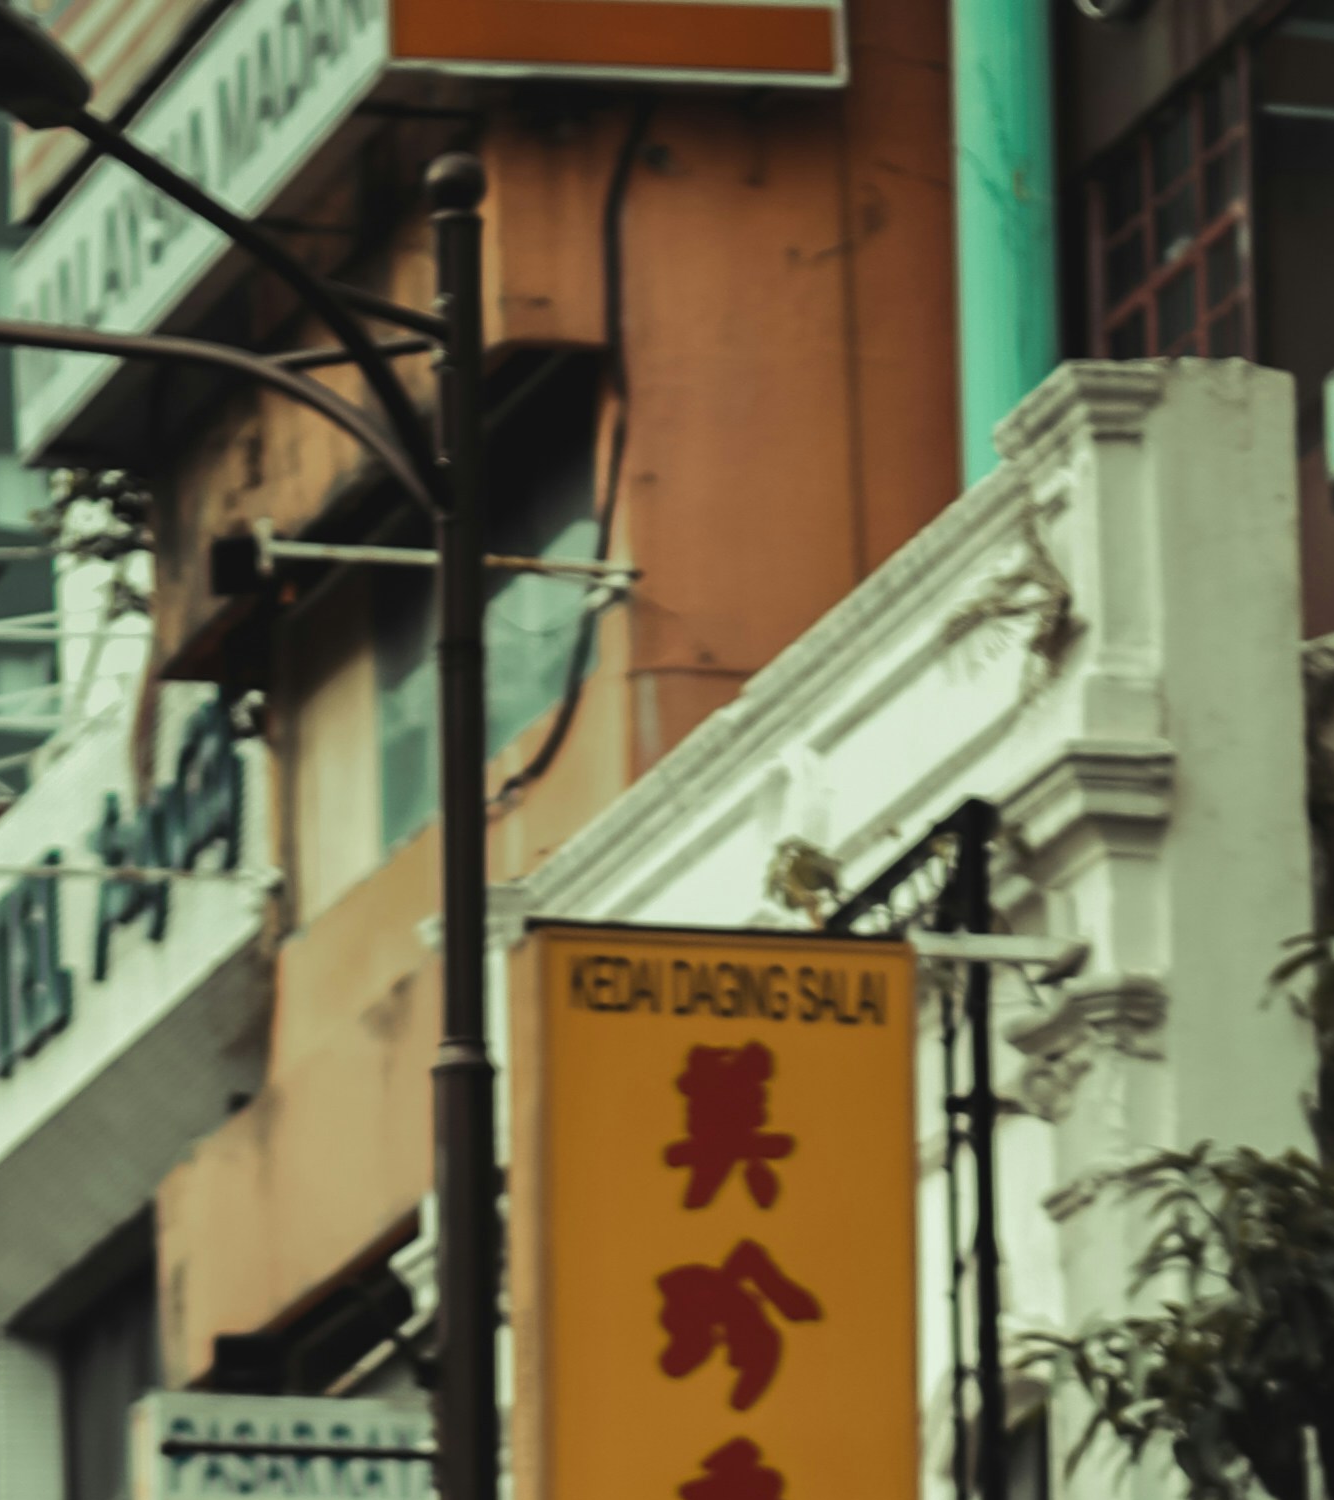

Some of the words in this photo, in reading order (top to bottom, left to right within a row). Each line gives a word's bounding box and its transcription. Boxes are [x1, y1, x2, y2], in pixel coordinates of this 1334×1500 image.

[570, 954, 662, 1014] KEDAI
[671, 958, 791, 1022] DAGING
[798, 966, 888, 1026] SALAI
